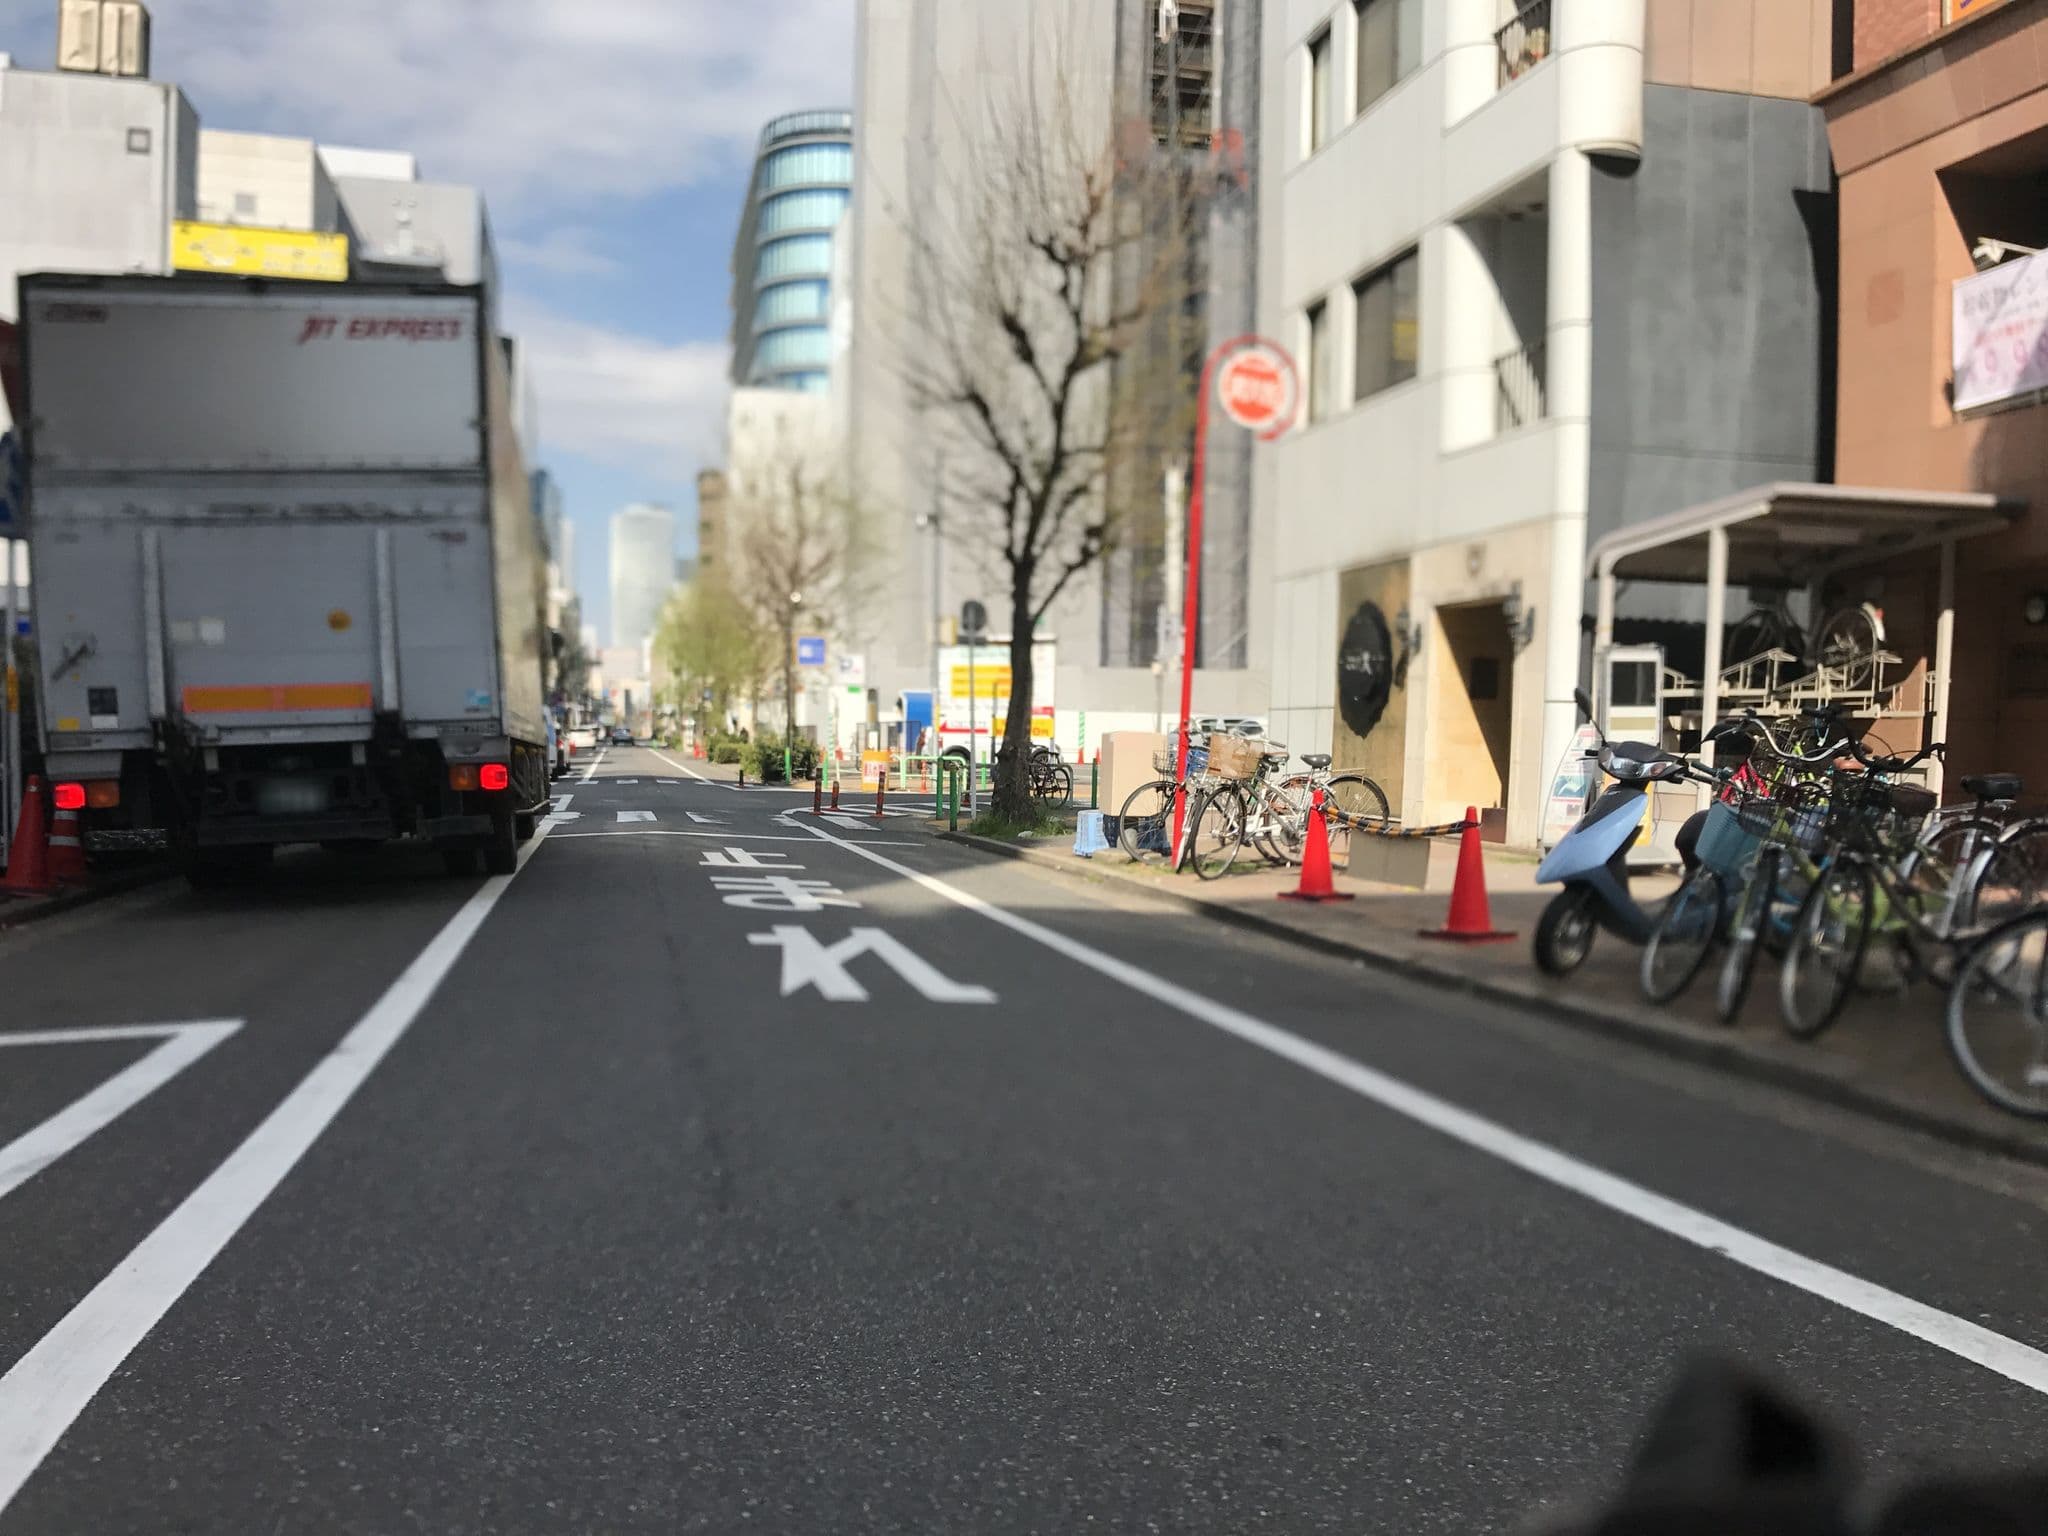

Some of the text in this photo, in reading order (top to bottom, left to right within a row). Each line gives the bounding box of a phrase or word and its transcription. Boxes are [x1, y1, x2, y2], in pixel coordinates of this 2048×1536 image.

[347, 316, 462, 341] EXPRESS
[699, 846, 999, 1004] 止まれ
